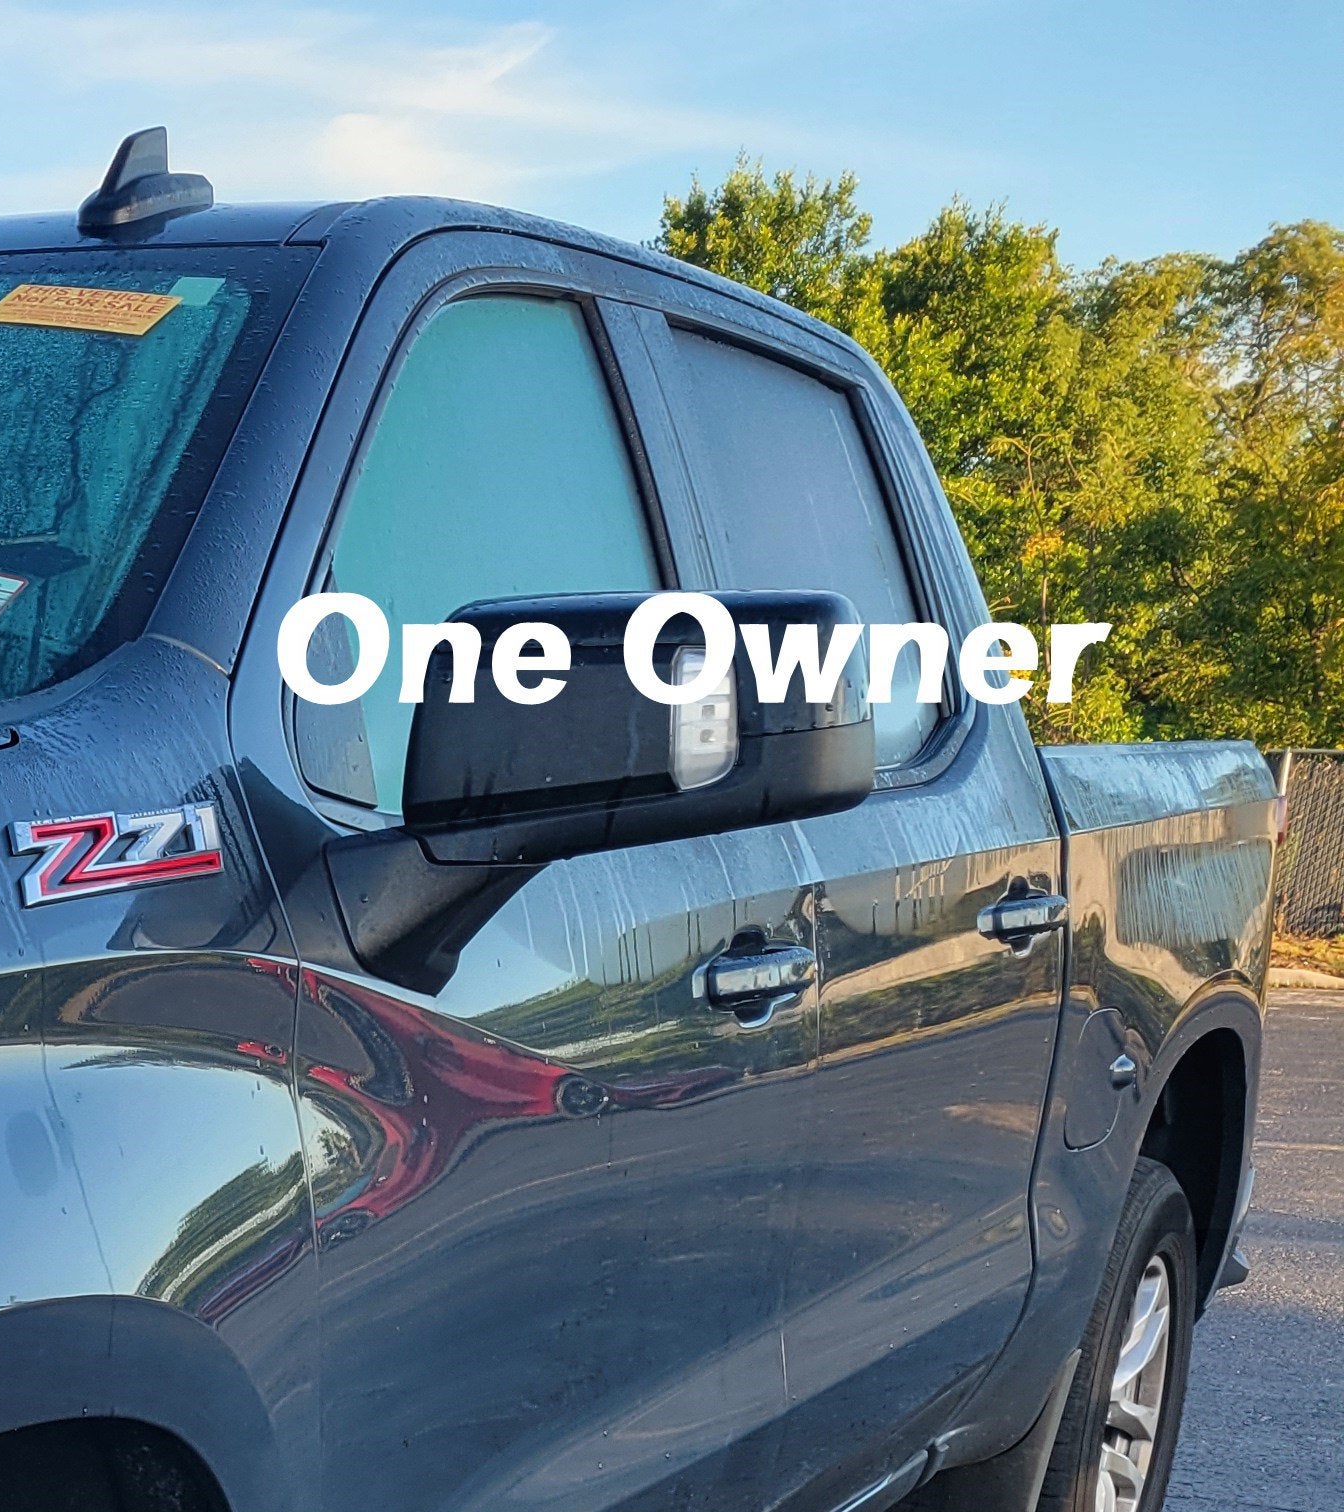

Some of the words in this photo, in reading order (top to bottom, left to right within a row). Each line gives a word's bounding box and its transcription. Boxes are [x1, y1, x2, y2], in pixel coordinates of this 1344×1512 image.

[25, 285, 72, 296] THIS
[78, 287, 174, 305] VEHICLE
[56, 296, 96, 307] FOR
[103, 300, 162, 315] SALE
[12, 802, 224, 906] Z71
